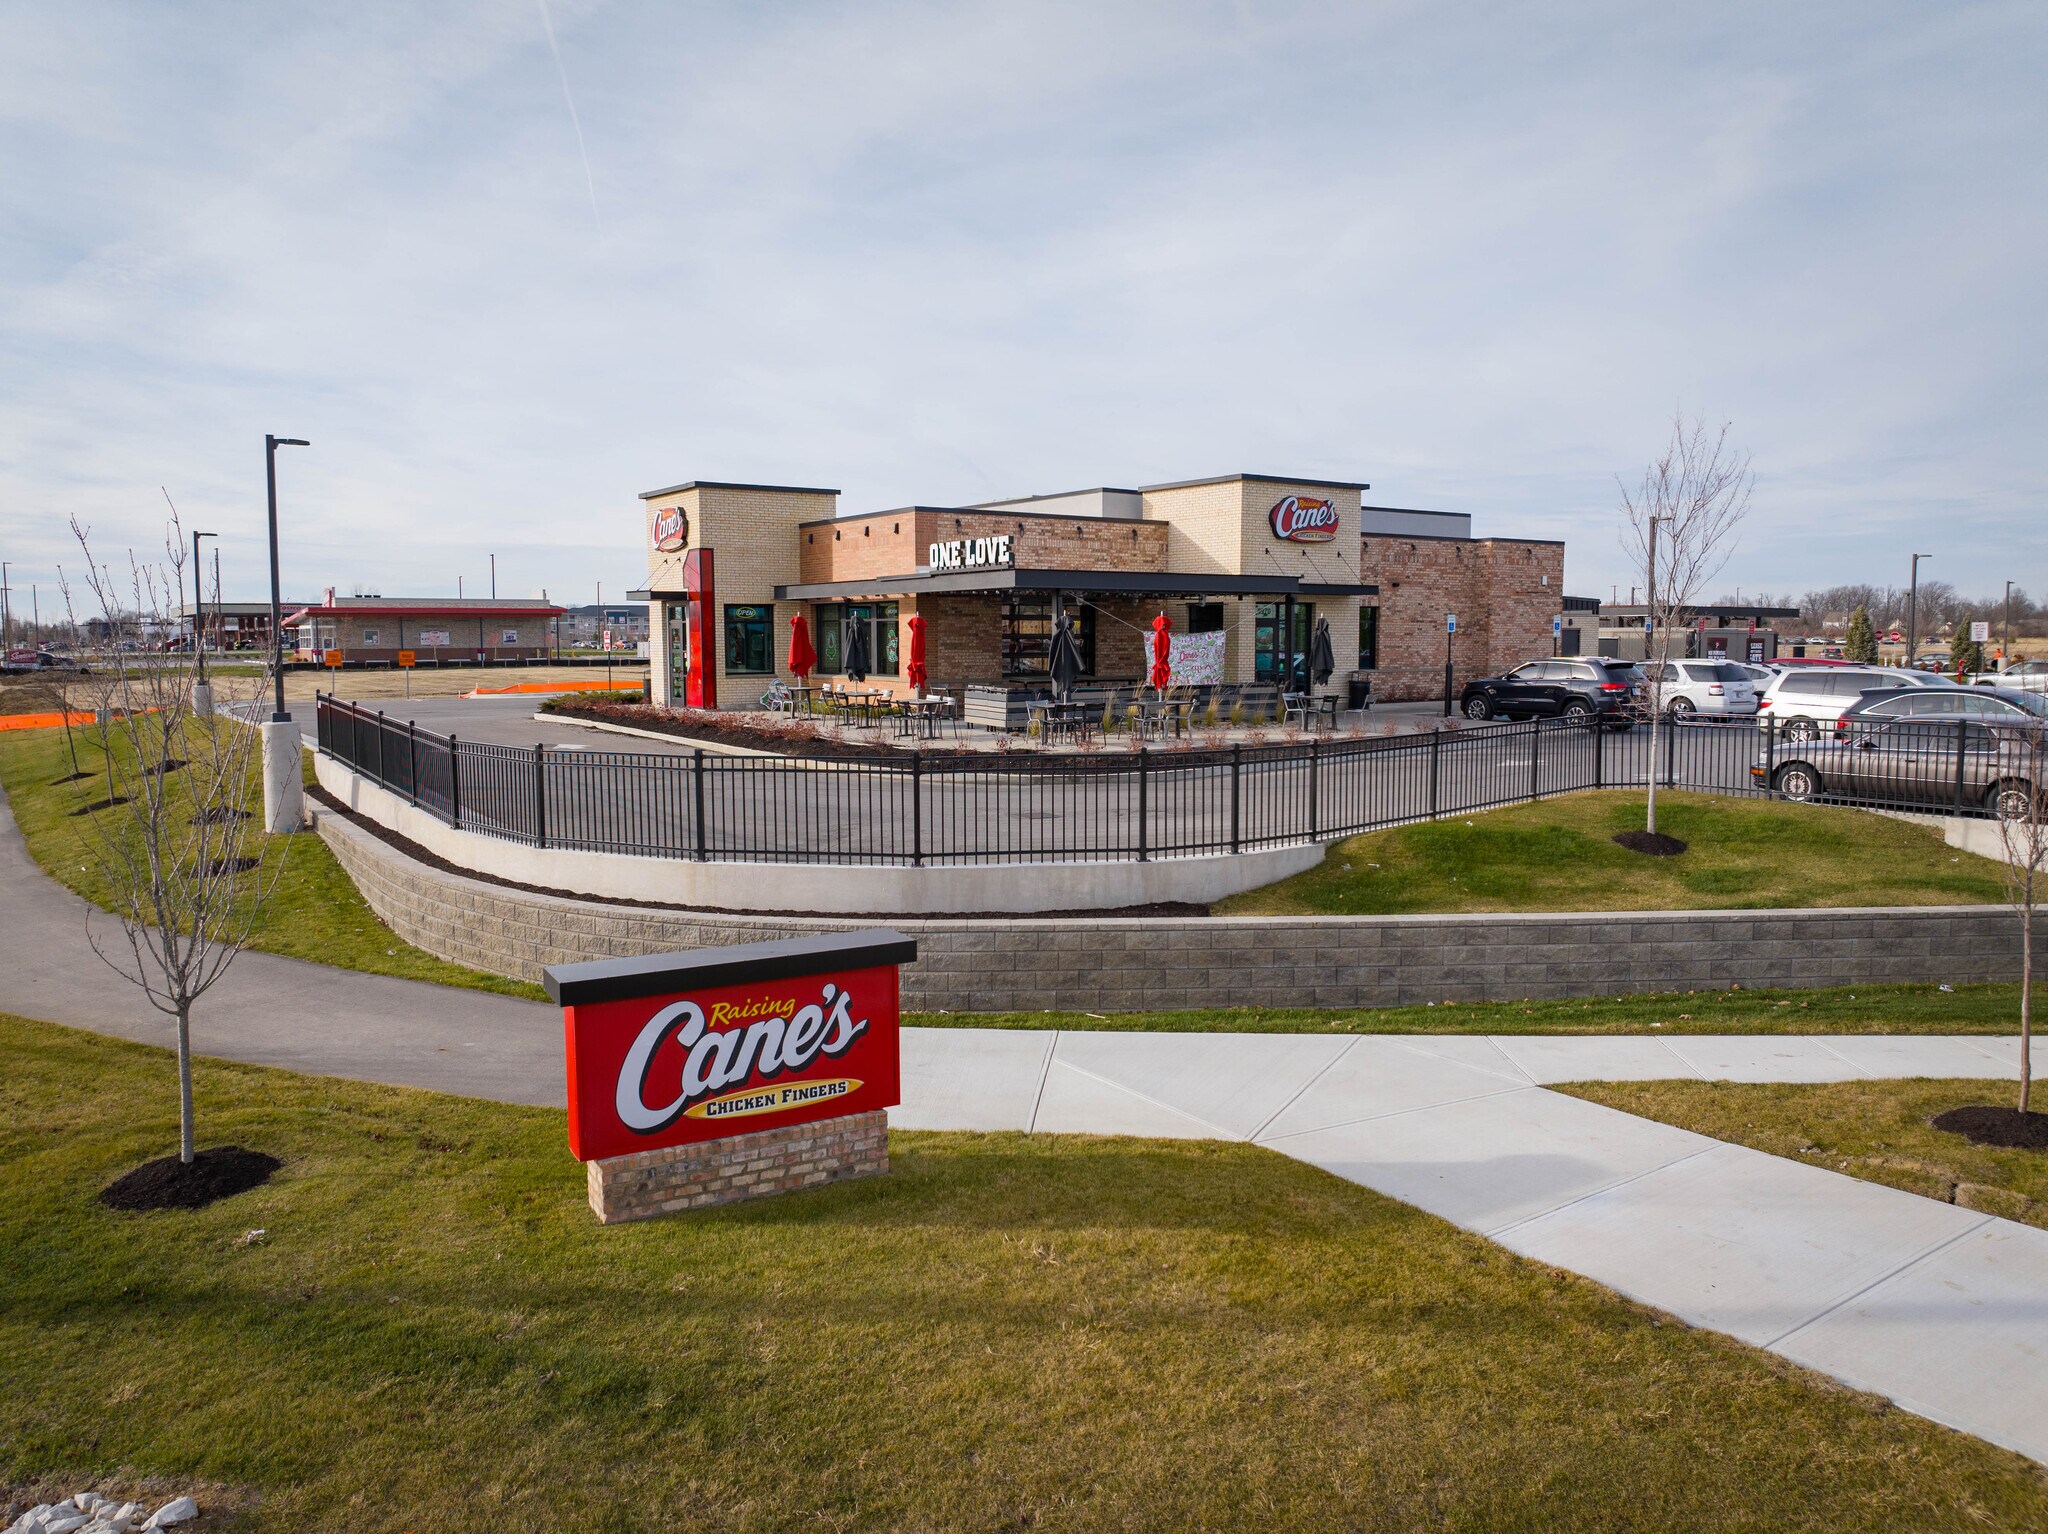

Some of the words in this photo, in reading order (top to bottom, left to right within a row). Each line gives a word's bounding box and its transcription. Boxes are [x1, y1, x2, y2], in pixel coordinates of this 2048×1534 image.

[653, 507, 683, 548] Cane's
[1276, 497, 1339, 537] Cane's
[929, 541, 961, 568] ONE
[965, 535, 1010, 565] LOVE
[709, 996, 795, 1027] Raising
[616, 983, 868, 1130] Cane's
[706, 1094, 776, 1116] CHICKEN
[781, 1081, 847, 1103] FINGERS
